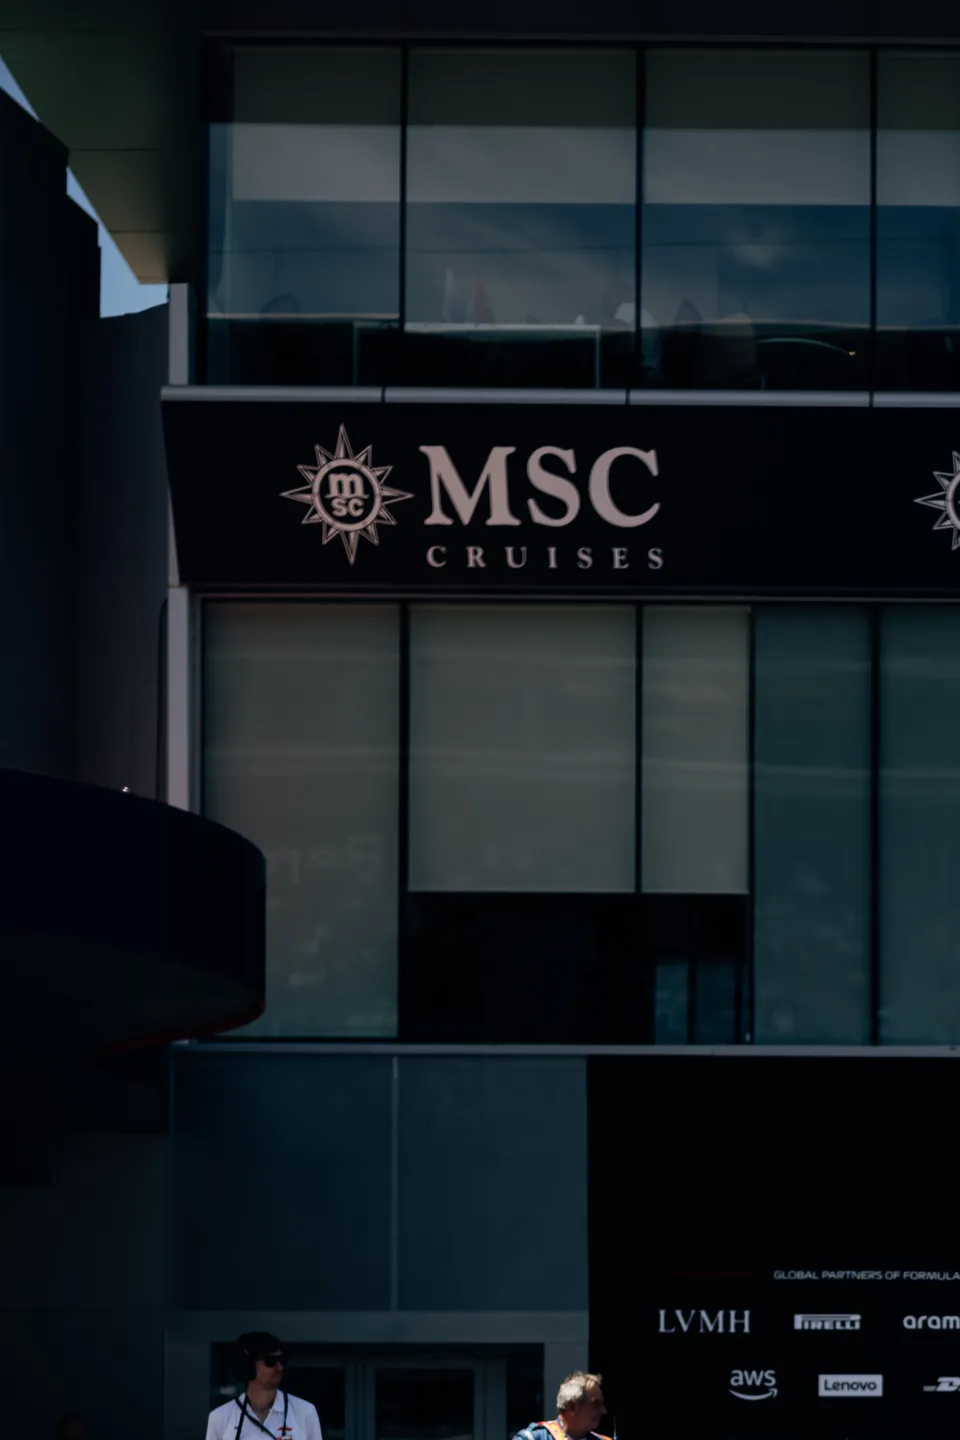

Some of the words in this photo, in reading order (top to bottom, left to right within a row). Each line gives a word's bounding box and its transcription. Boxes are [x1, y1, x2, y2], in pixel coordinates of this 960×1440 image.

[418, 445, 661, 528] MSC
[426, 545, 663, 571] CRUISES
[773, 1270, 820, 1281] GLOBAL
[821, 1270, 884, 1281] PARTNERS
[885, 1270, 901, 1281] OF
[902, 1270, 960, 1282] FORMULA
[658, 1309, 751, 1333] LVMH
[793, 1313, 862, 1331] PIRELLI
[730, 1369, 777, 1388] aws
[824, 1379, 877, 1391] Lenovo
